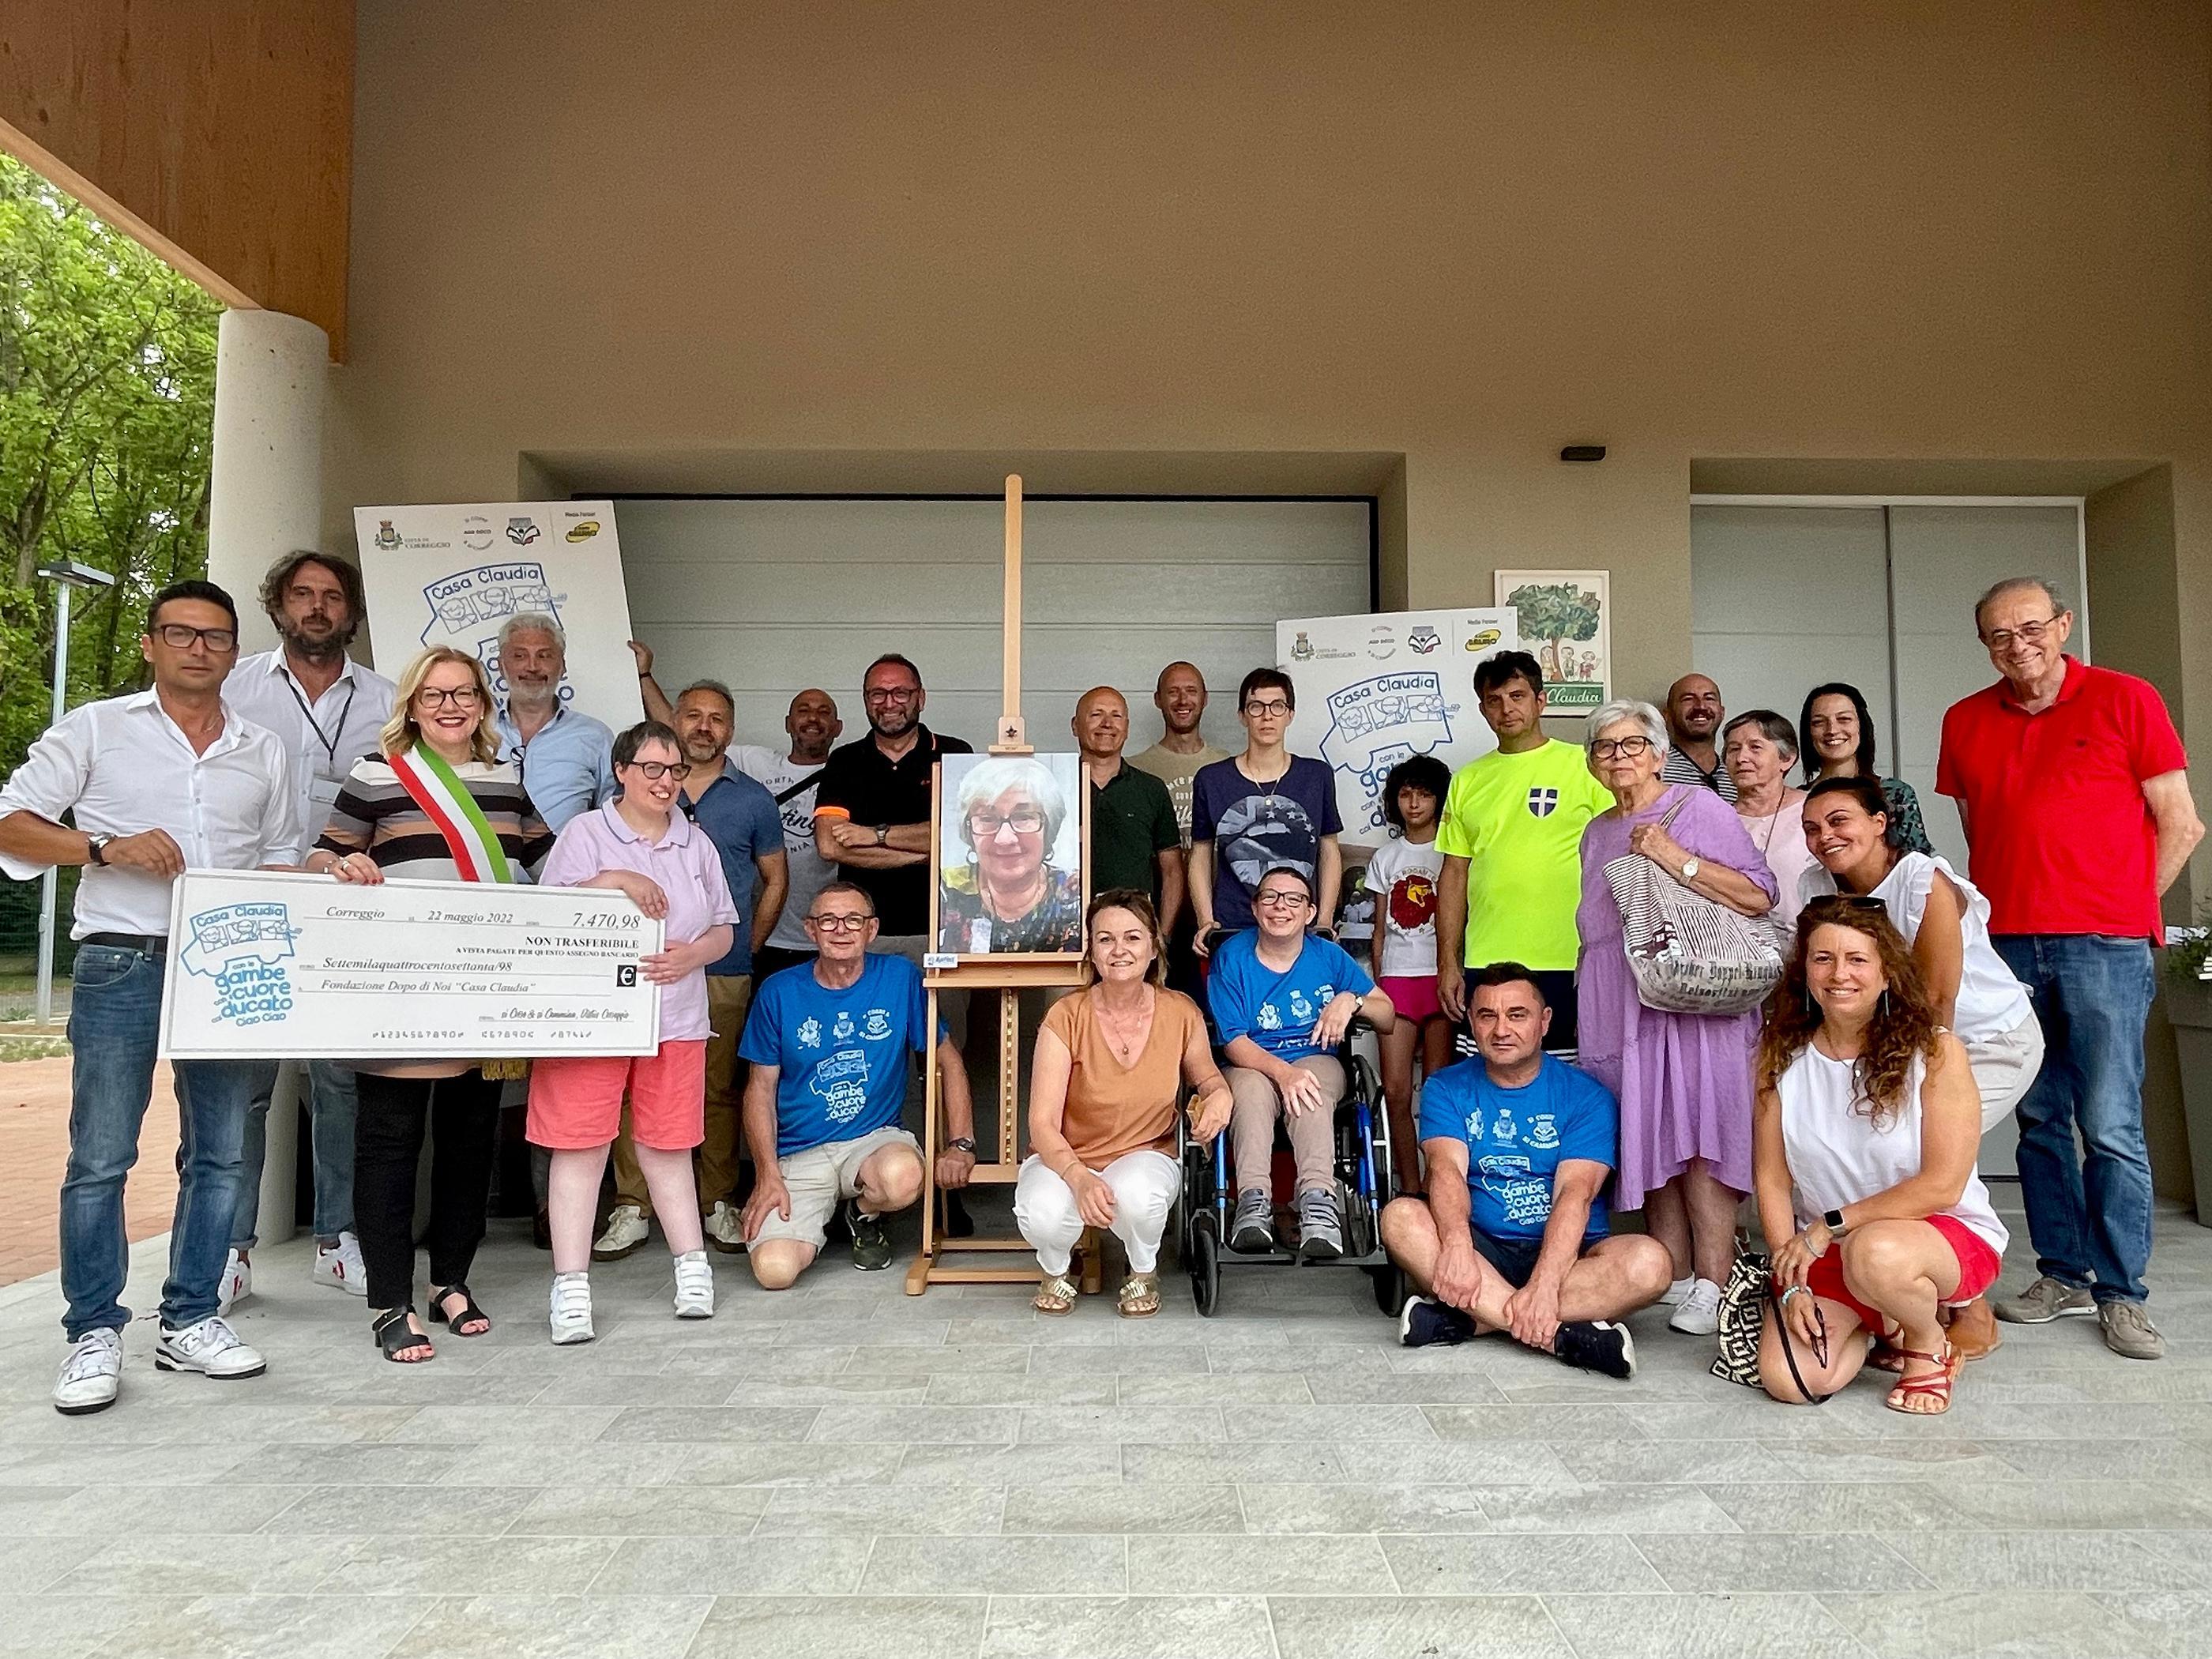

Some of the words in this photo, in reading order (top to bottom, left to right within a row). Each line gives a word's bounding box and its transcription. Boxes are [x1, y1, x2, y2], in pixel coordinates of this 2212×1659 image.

[431, 578, 472, 600] Casa
[478, 566, 540, 584] Claudia
[1334, 687, 1371, 708] Casa
[1377, 677, 1435, 693] Claudia
[1546, 687, 1601, 704] Claudia
[1379, 752, 1395, 763] con
[196, 911, 230, 927] Casa
[235, 905, 284, 917] Claudia
[325, 906, 386, 920] Correggio
[427, 910, 442, 921] 22
[444, 912, 485, 925] maggio
[487, 912, 514, 924] 2022
[572, 912, 641, 930] 7.470,98
[525, 935, 551, 946] NON
[554, 937, 639, 949] TRASFERIBILE
[322, 957, 513, 972] Settemilaquattrocentosettanta/98
[214, 962, 285, 995] gambe
[321, 979, 385, 991] Fondazione
[387, 980, 417, 993] Dopo
[419, 981, 430, 991] di
[432, 981, 452, 991] Noi
[455, 982, 487, 992] "Casa
[489, 982, 536, 992] Claudia"
[232, 980, 292, 1000] cuore
[220, 995, 293, 1018] ducato
[236, 1015, 261, 1027] Ciao
[261, 1012, 287, 1022] Ciao
[826, 1086, 863, 1106] gambe
[836, 1095, 866, 1108] cuore
[1502, 1182, 1545, 1204] gambe
[1514, 1193, 1550, 1207] cuore
[1508, 1203, 1552, 1219] ducato
